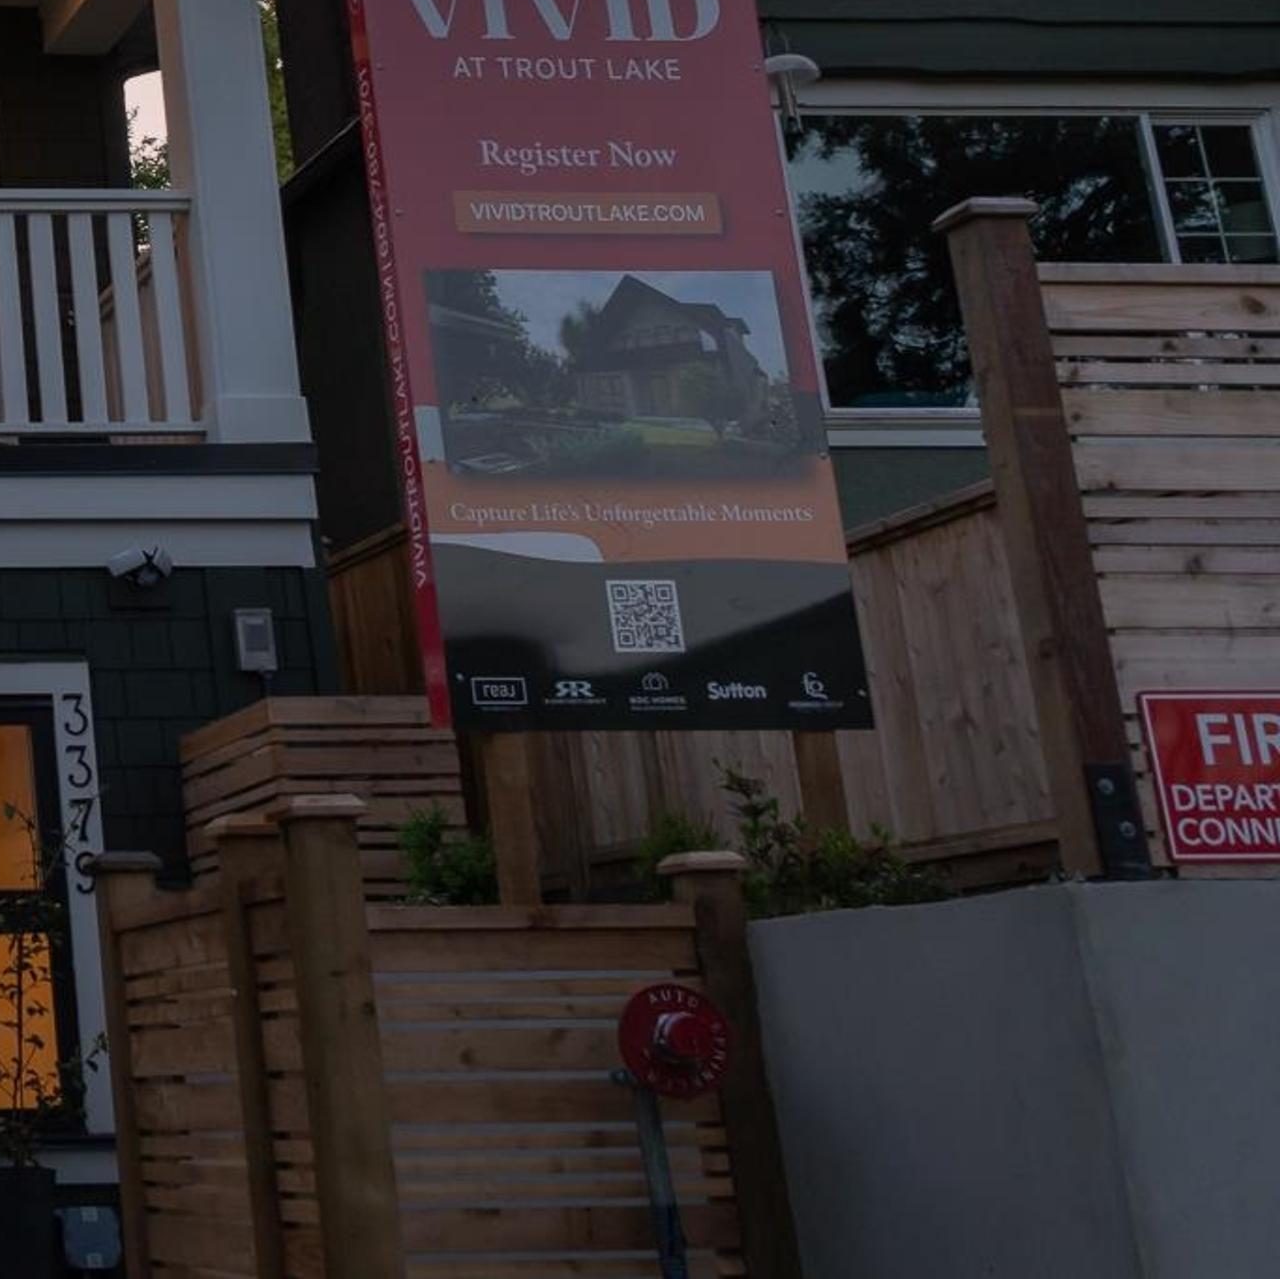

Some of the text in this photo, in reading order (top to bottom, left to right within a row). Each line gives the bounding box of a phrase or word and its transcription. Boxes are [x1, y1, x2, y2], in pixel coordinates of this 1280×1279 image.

[453, 56, 682, 81] AT TROUT LAKE
[479, 140, 678, 175] Register Now
[470, 202, 706, 223] VIVIDTROUTLAKE.COM
[450, 502, 815, 528] Capture Life's Unforgettable Moments
[706, 681, 768, 700] Sutton
[1176, 816, 1280, 847] CONN
